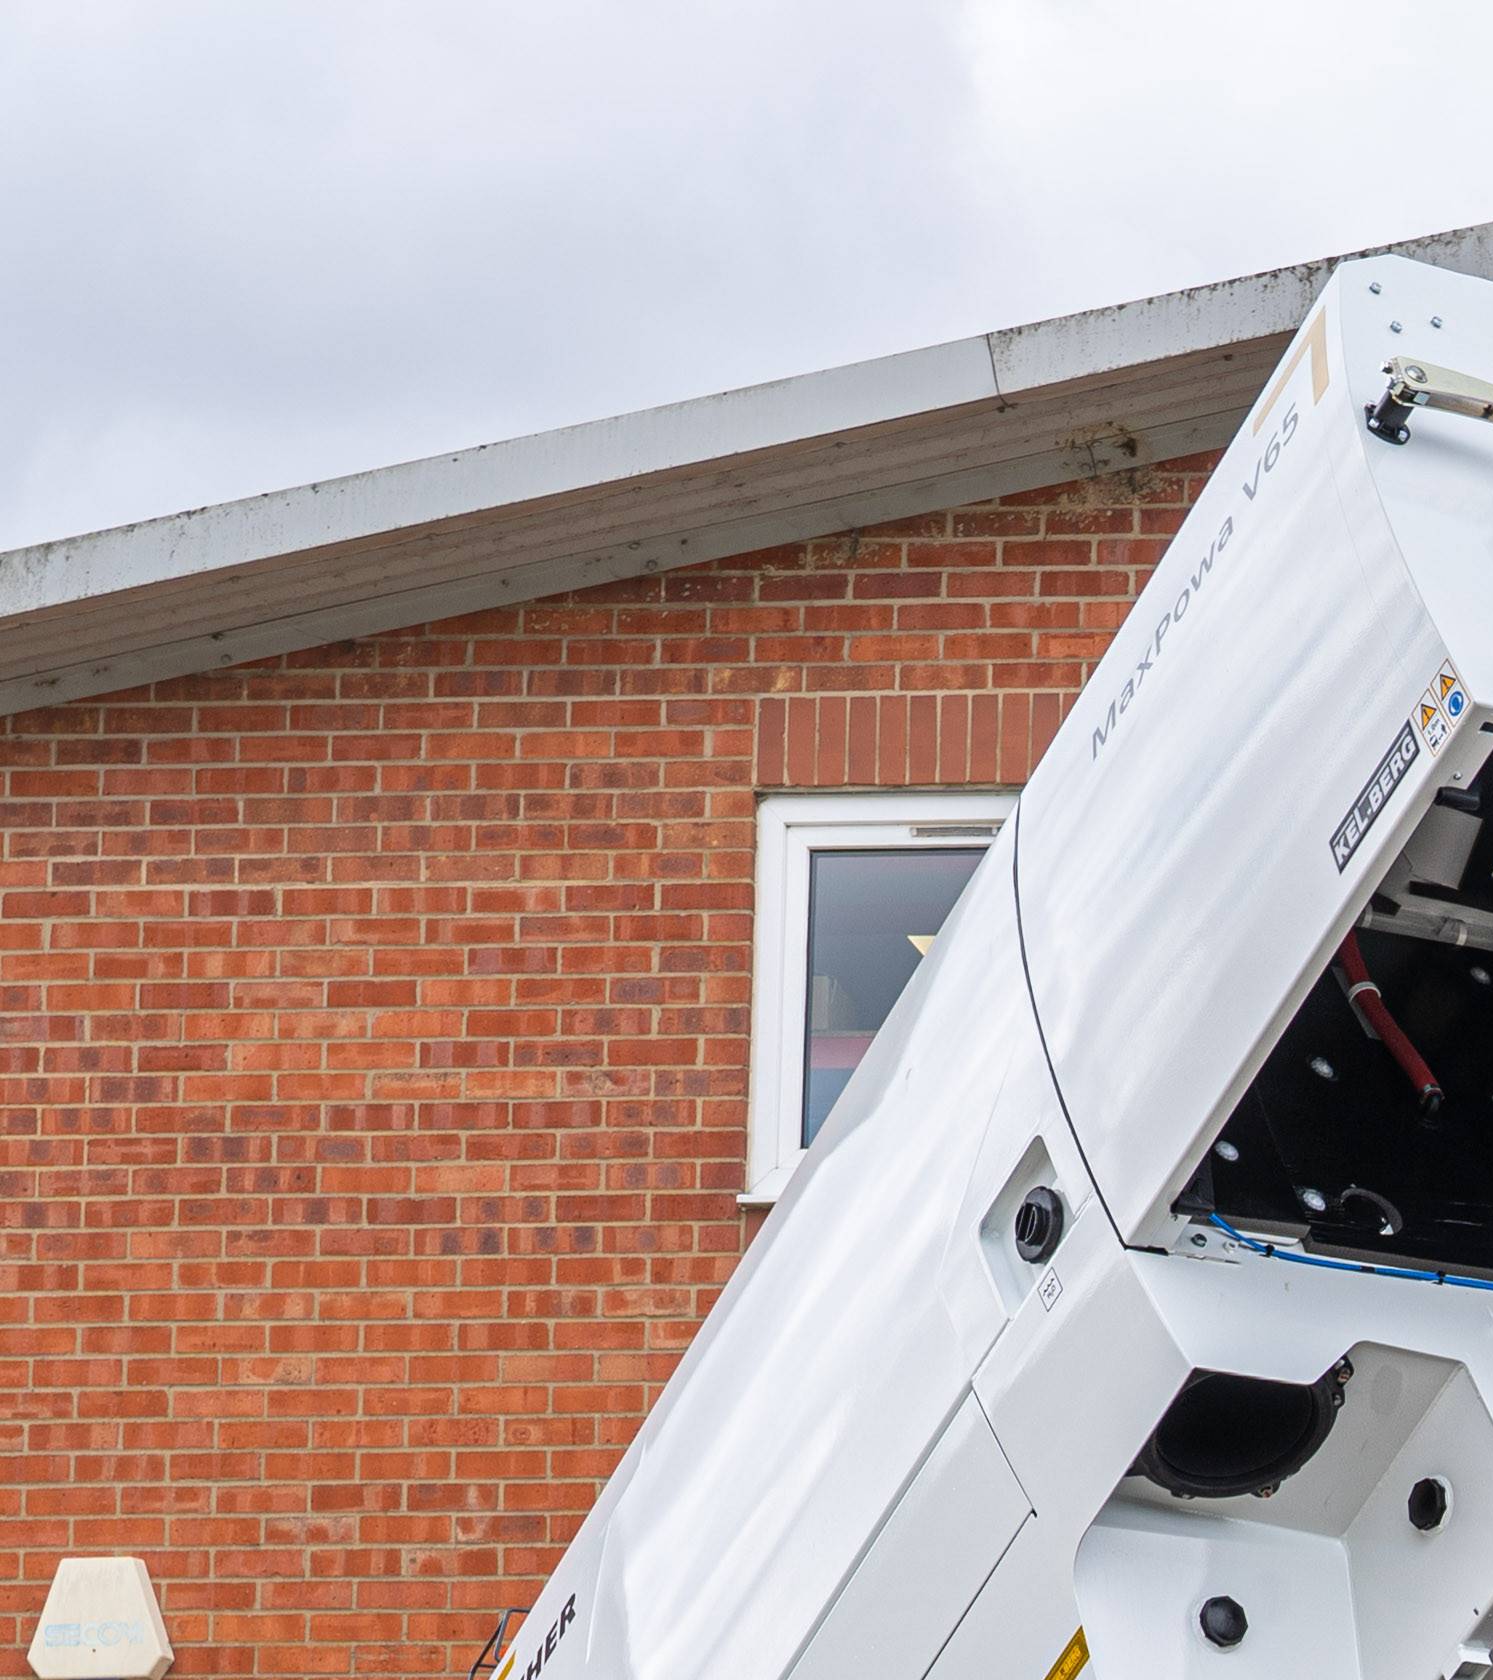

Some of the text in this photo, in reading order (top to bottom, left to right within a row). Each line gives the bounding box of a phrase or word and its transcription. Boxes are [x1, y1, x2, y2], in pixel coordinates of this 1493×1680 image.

[1089, 402, 1301, 761] MaxPowa V65
[1335, 736, 1417, 866] KEL-BERG
